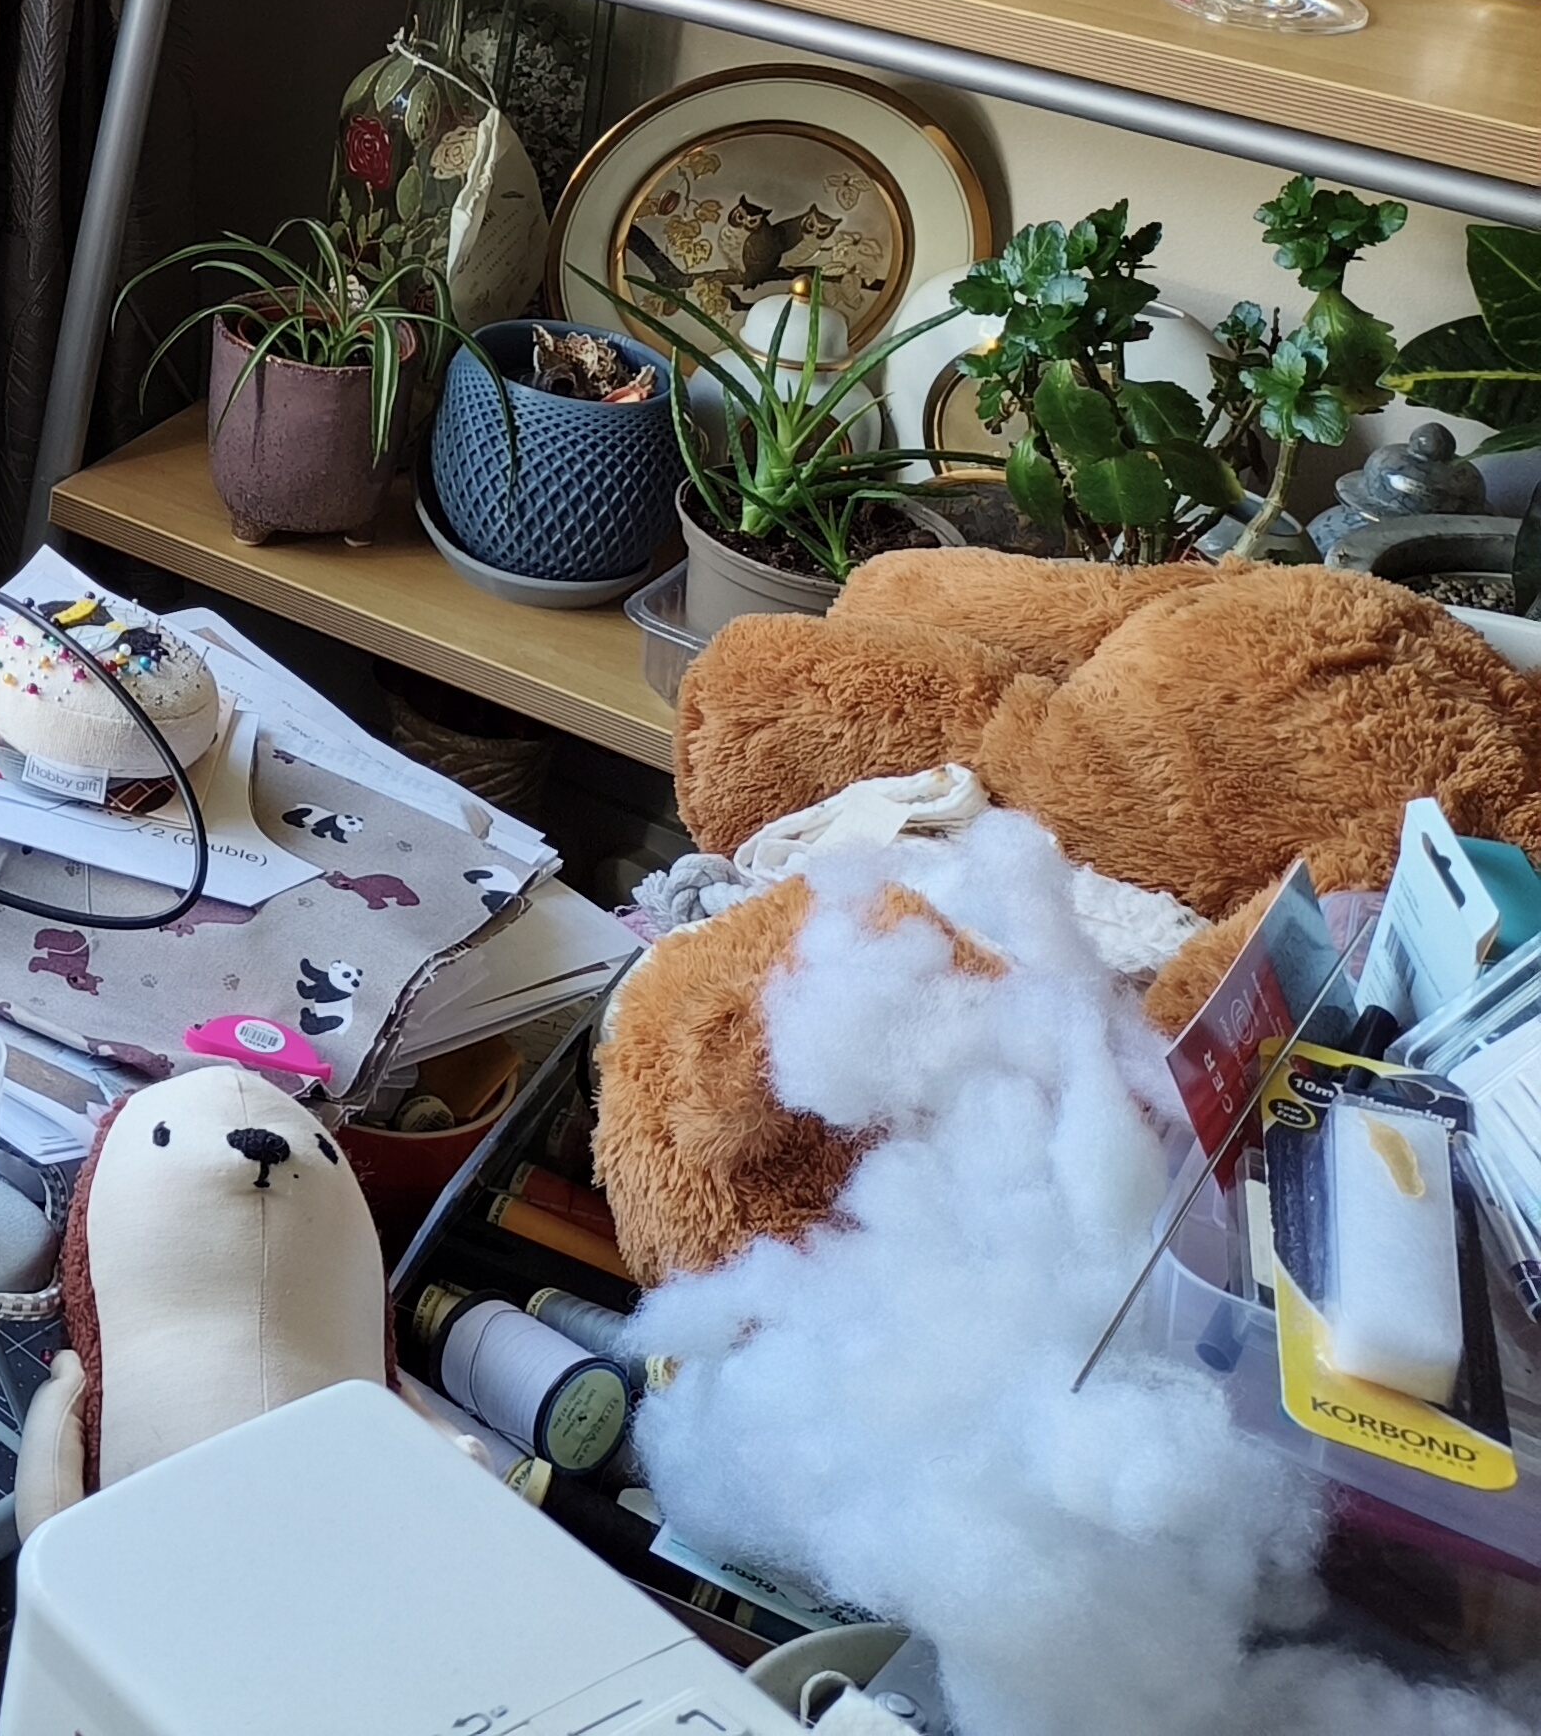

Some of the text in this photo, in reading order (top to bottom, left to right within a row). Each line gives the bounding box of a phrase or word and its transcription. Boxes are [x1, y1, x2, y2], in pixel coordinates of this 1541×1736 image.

[30, 761, 99, 794] hobby gift
[151, 827, 268, 867] 2 (duble)
[1293, 1077, 1335, 1098] 10m
[1275, 1101, 1303, 1115] Sew
[1276, 1109, 1304, 1124] Free
[1359, 1094, 1458, 1130] Hemming
[1310, 1396, 1477, 1463] KORBOND
[1347, 1425, 1392, 1446] CARE
[1412, 1449, 1475, 1472] REPAIR
